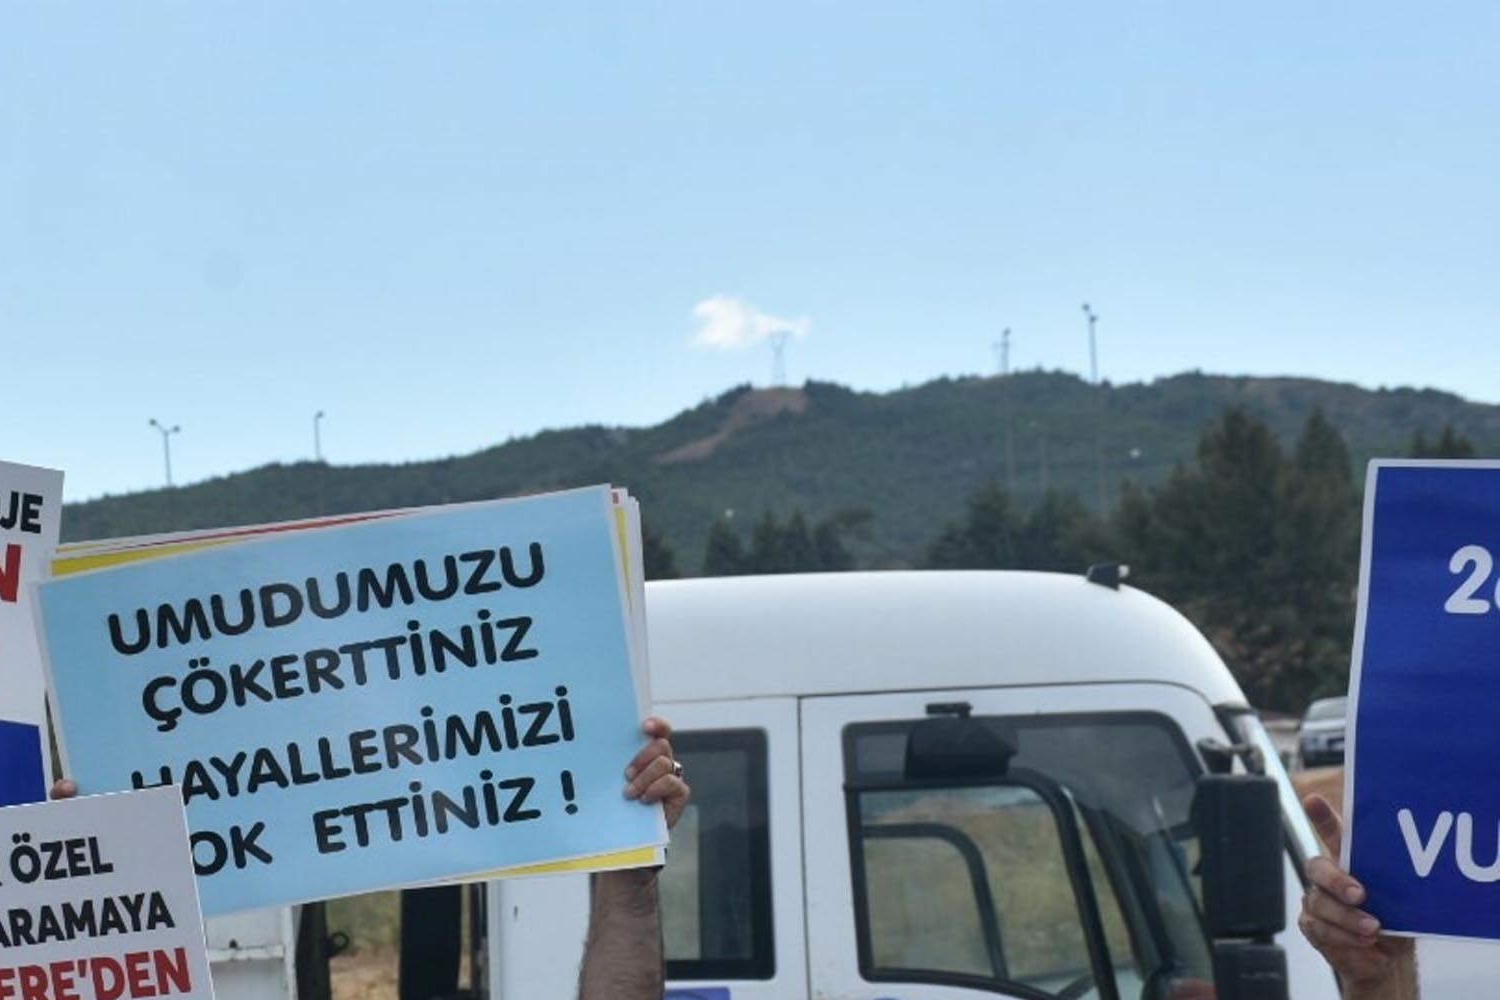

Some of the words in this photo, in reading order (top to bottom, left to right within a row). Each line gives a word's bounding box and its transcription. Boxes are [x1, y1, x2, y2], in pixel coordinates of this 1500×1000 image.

[108, 542, 547, 656] UMUDUMUZU
[1445, 546, 1500, 613] 2
[141, 607, 538, 733] ÇÖKERTTİNİZ
[313, 770, 541, 854] ETTİNİZ
[561, 770, 578, 814] !
[10, 833, 113, 883] ÖZEL
